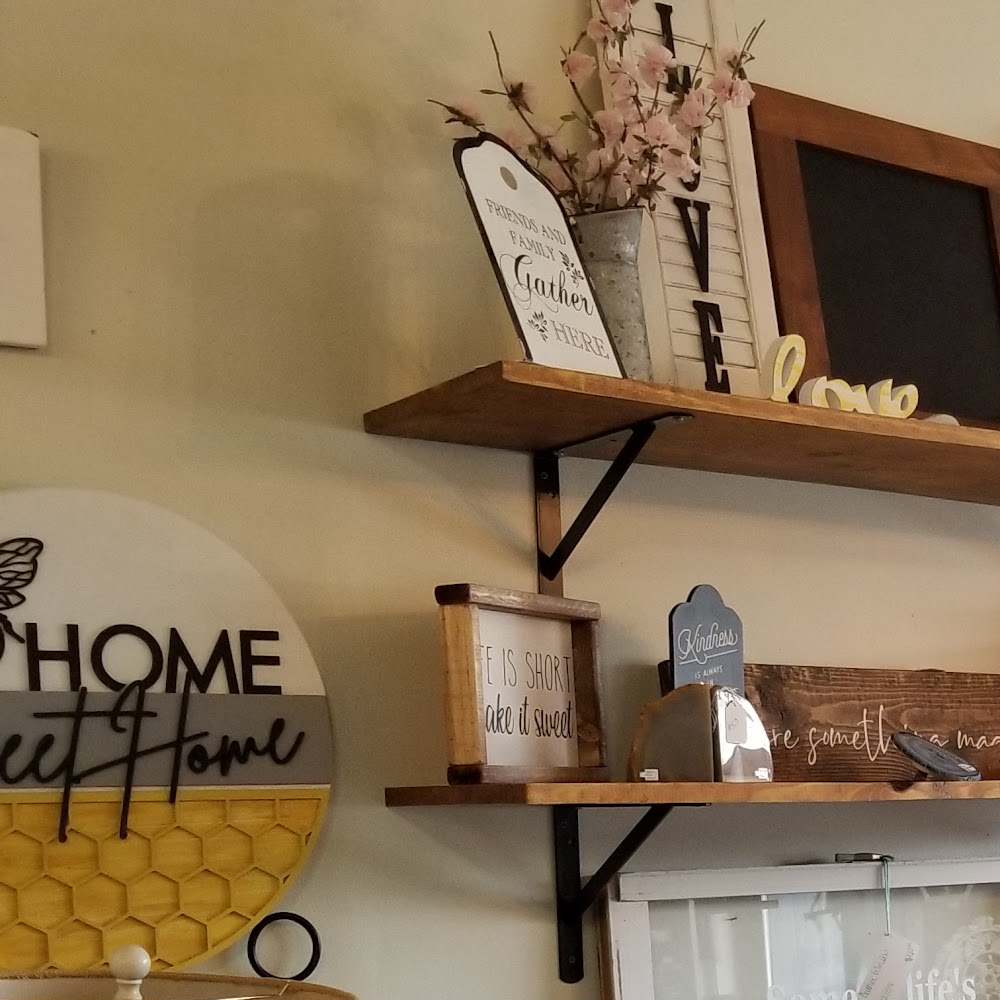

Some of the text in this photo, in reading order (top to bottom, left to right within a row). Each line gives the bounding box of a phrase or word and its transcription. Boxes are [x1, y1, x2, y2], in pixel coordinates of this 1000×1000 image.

[485, 197, 568, 246] FRIENDS AND
[509, 229, 557, 262] FAMILY
[500, 253, 595, 317] Gather
[550, 318, 610, 360] HERE
[24, 621, 283, 696] HOME
[677, 620, 739, 661] Kindness
[502, 647, 518, 688] IS
[525, 651, 573, 694] SHORT
[702, 665, 724, 678] ALWAYS
[485, 692, 575, 740] ake it sweet
[0, 670, 306, 844] eet Home
